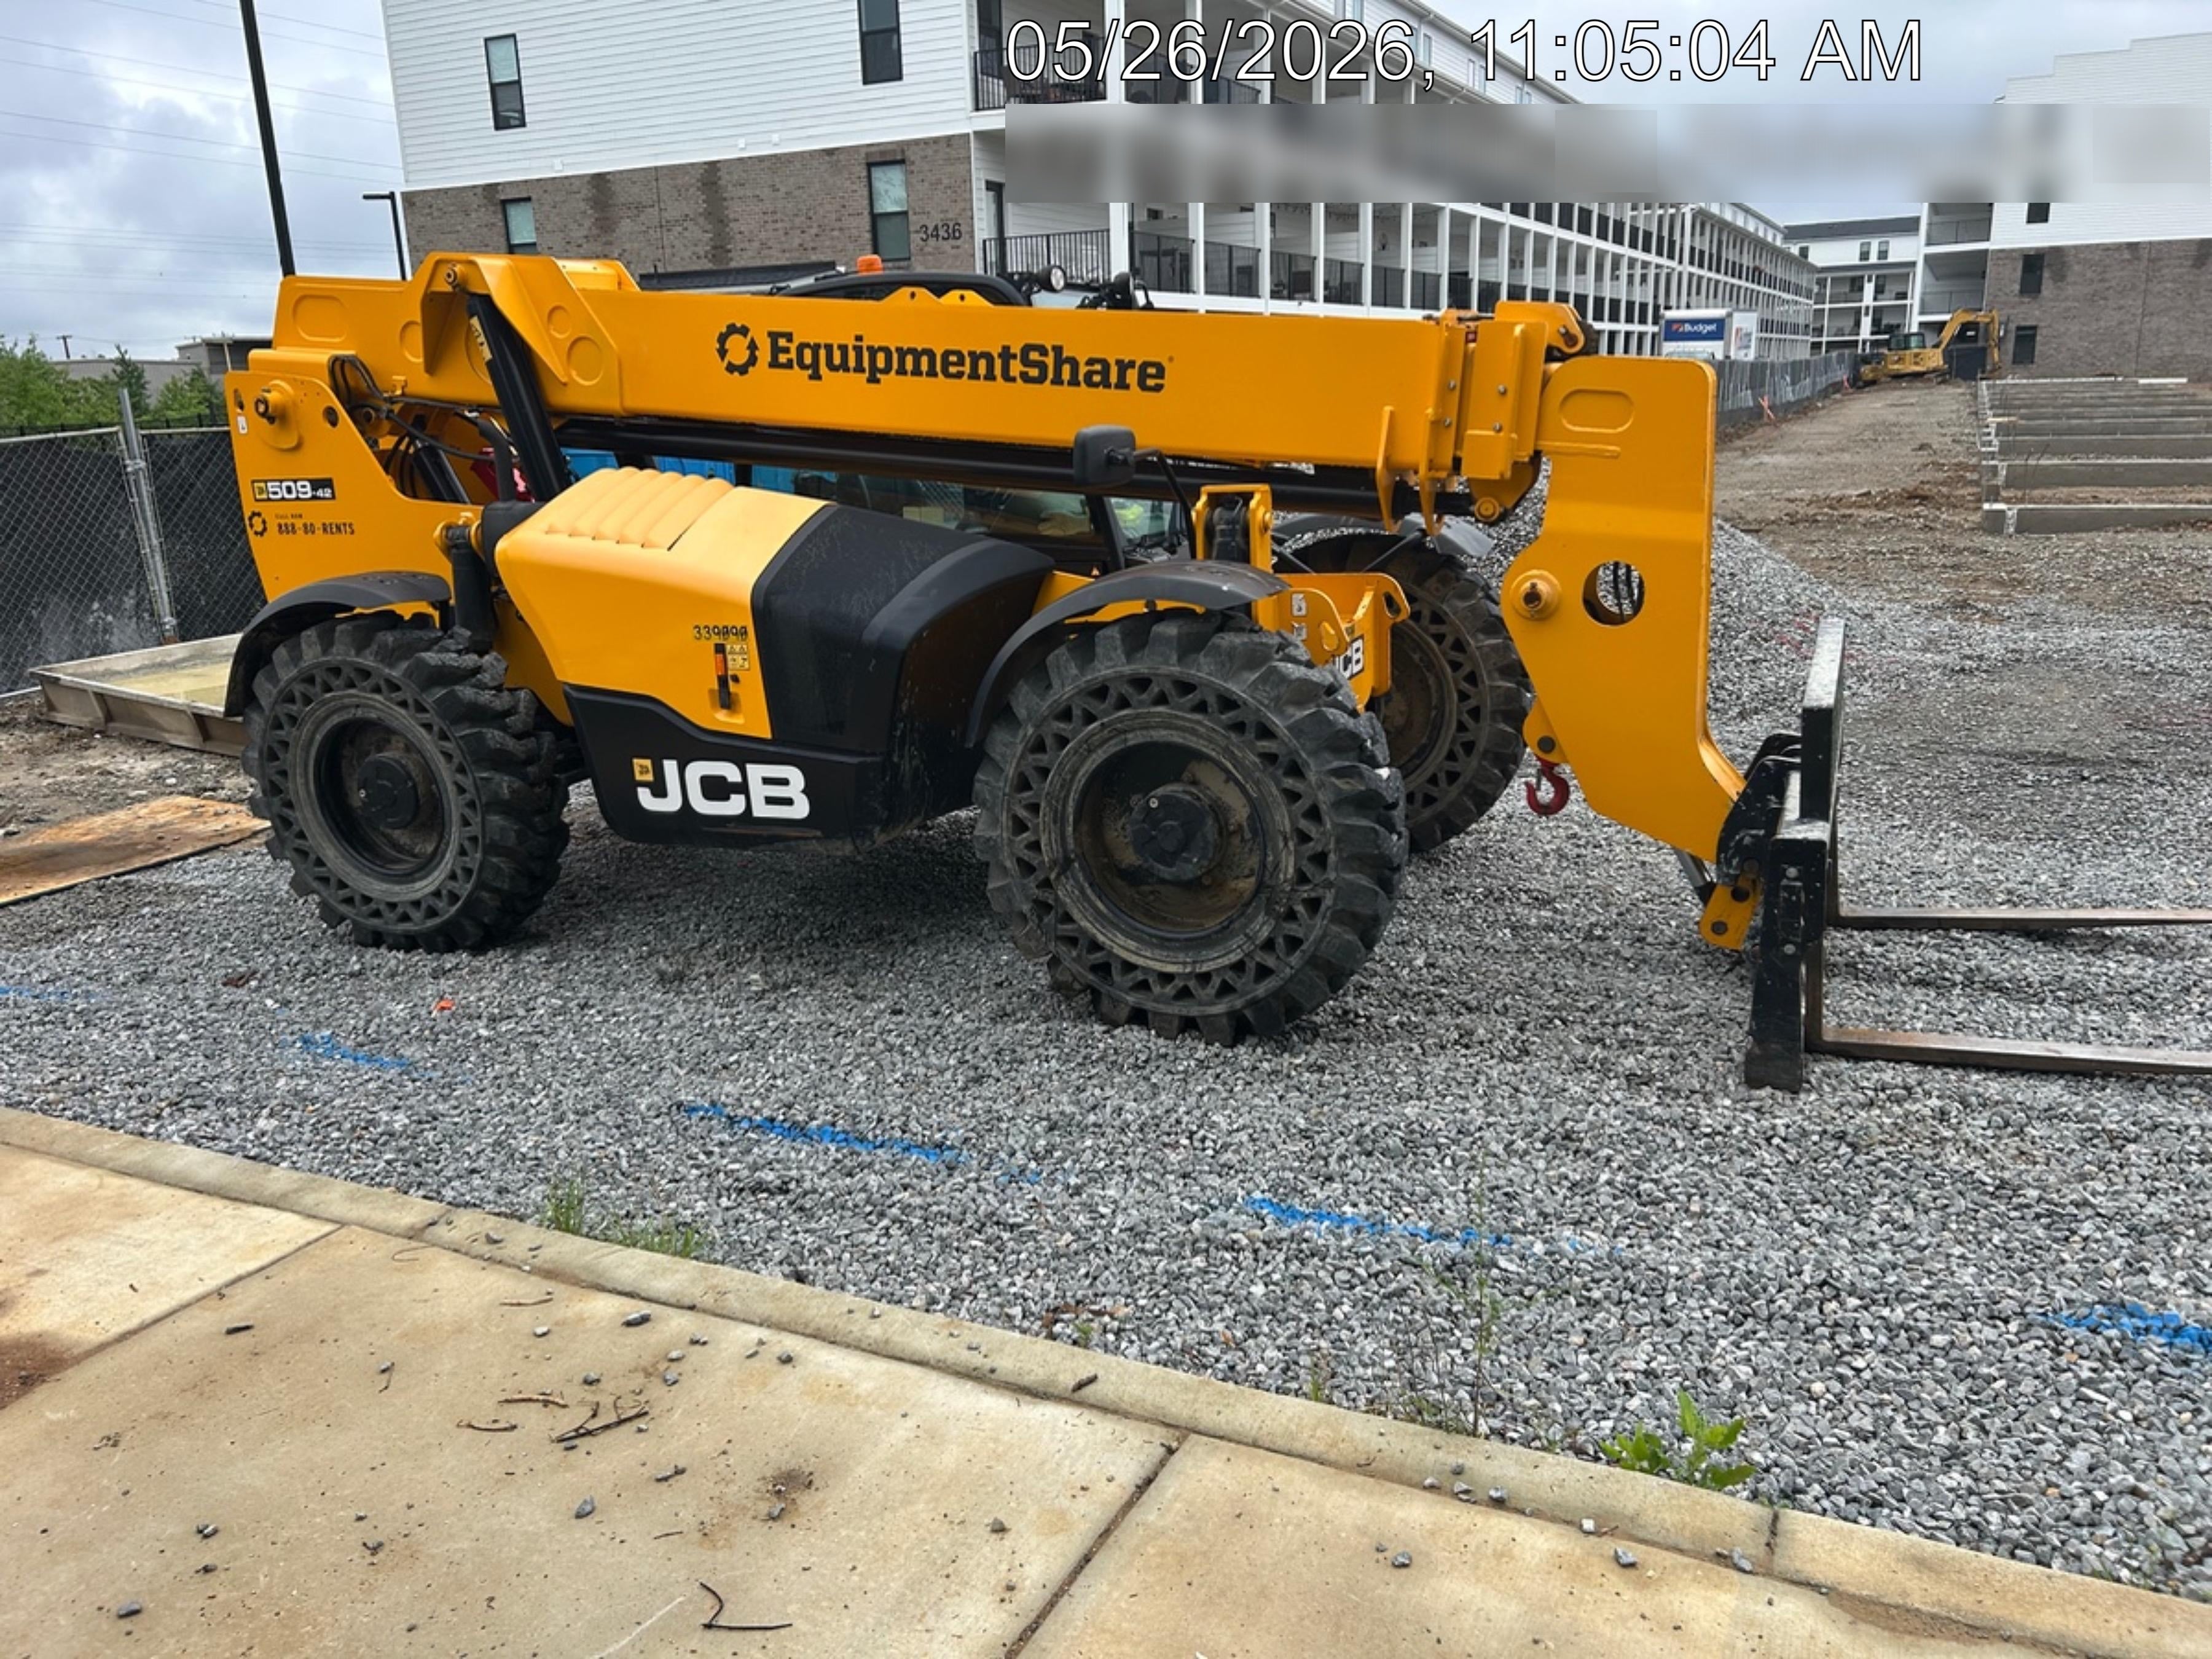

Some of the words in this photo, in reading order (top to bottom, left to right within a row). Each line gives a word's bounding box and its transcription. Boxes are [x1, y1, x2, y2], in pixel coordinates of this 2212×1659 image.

[919, 222, 963, 242] 3436
[1684, 322, 1717, 334] Budget
[766, 330, 1166, 393] EquipmentShare
[266, 480, 332, 500] 509-42
[692, 624, 748, 641] 339090
[636, 759, 810, 820] JCB
